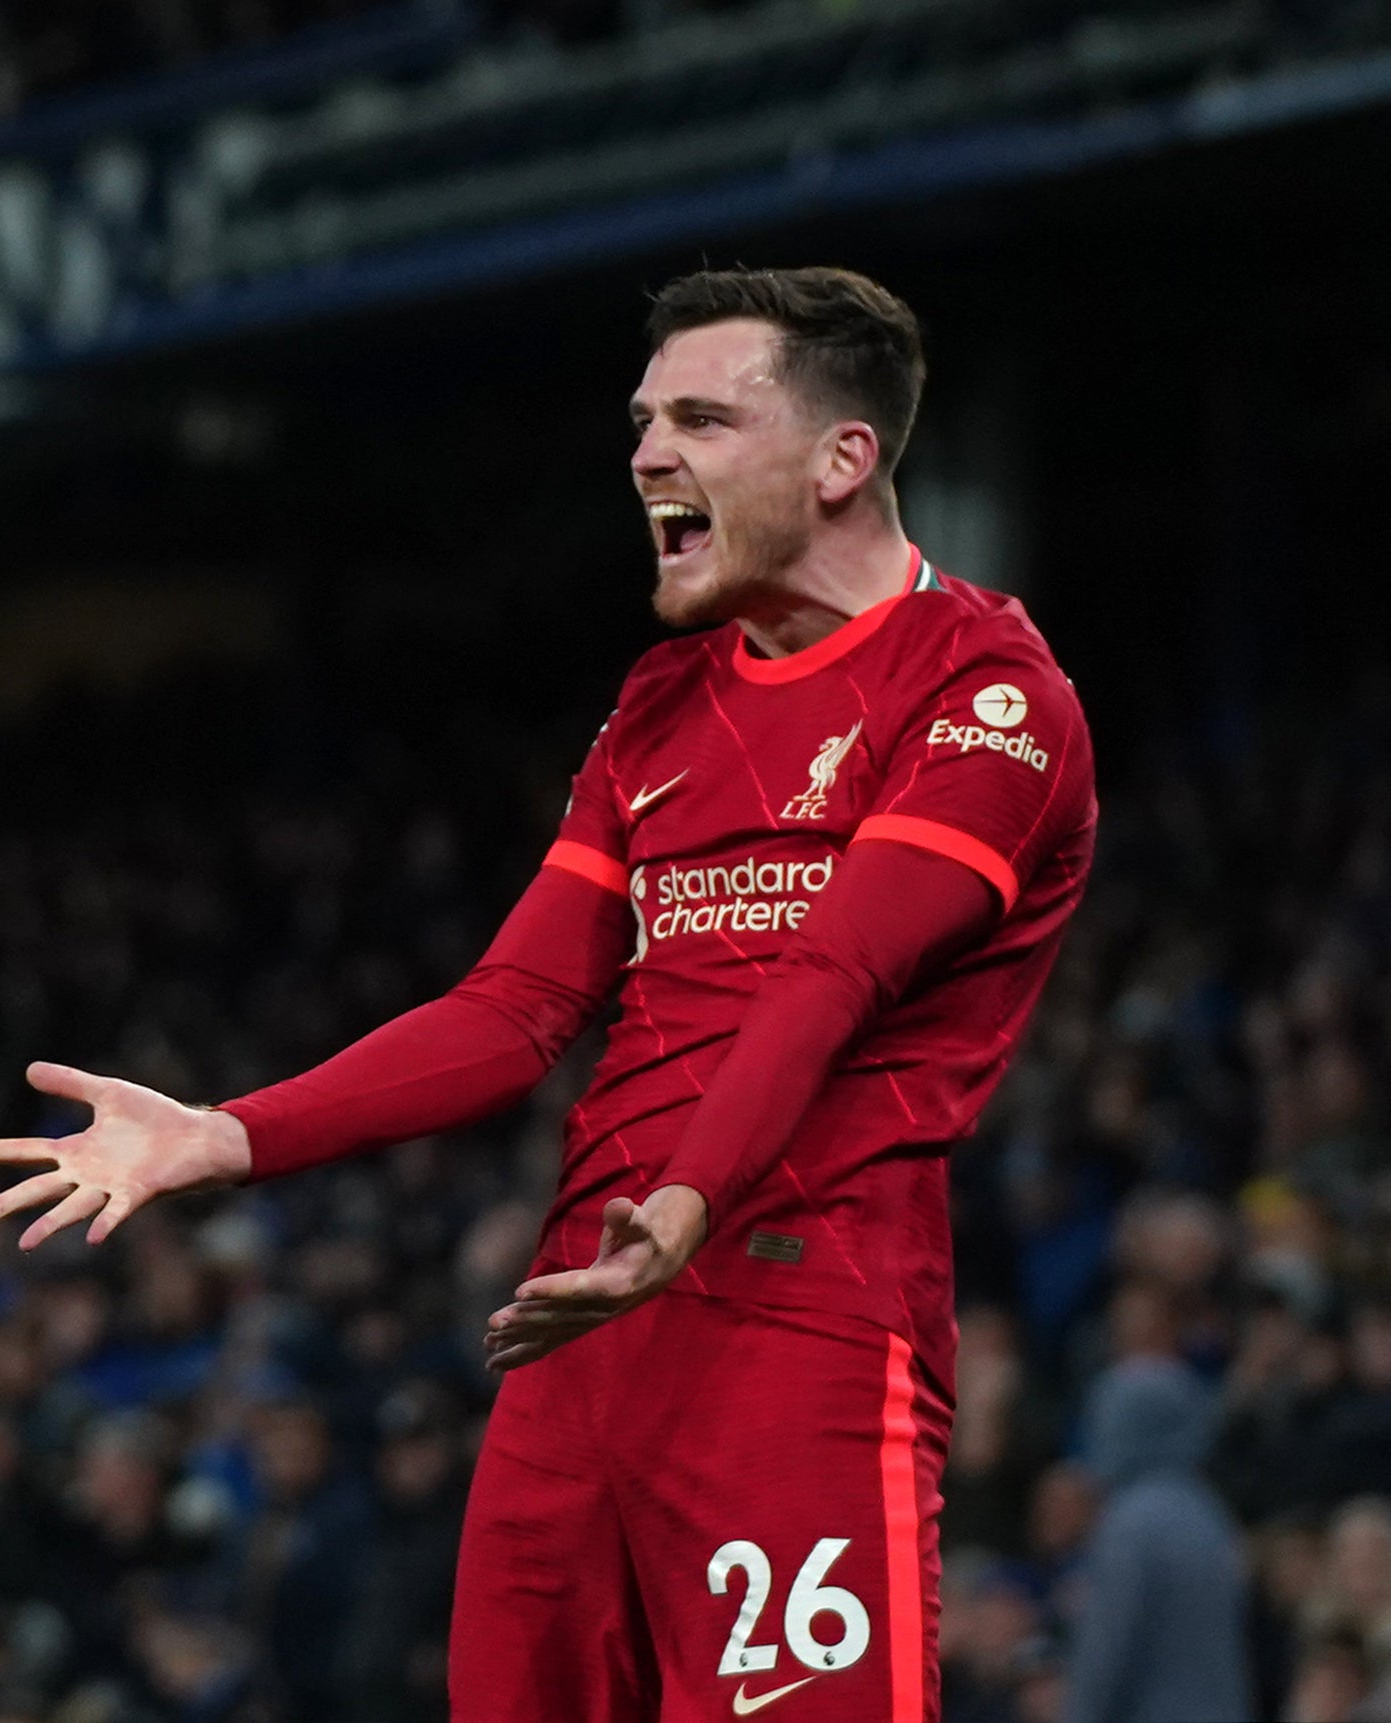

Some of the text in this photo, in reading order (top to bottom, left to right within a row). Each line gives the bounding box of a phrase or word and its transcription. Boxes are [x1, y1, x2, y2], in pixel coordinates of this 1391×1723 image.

[926, 719, 1048, 772] Expedia
[658, 855, 833, 905] standard
[652, 897, 811, 939] chartere
[706, 1537, 871, 1676] 26
